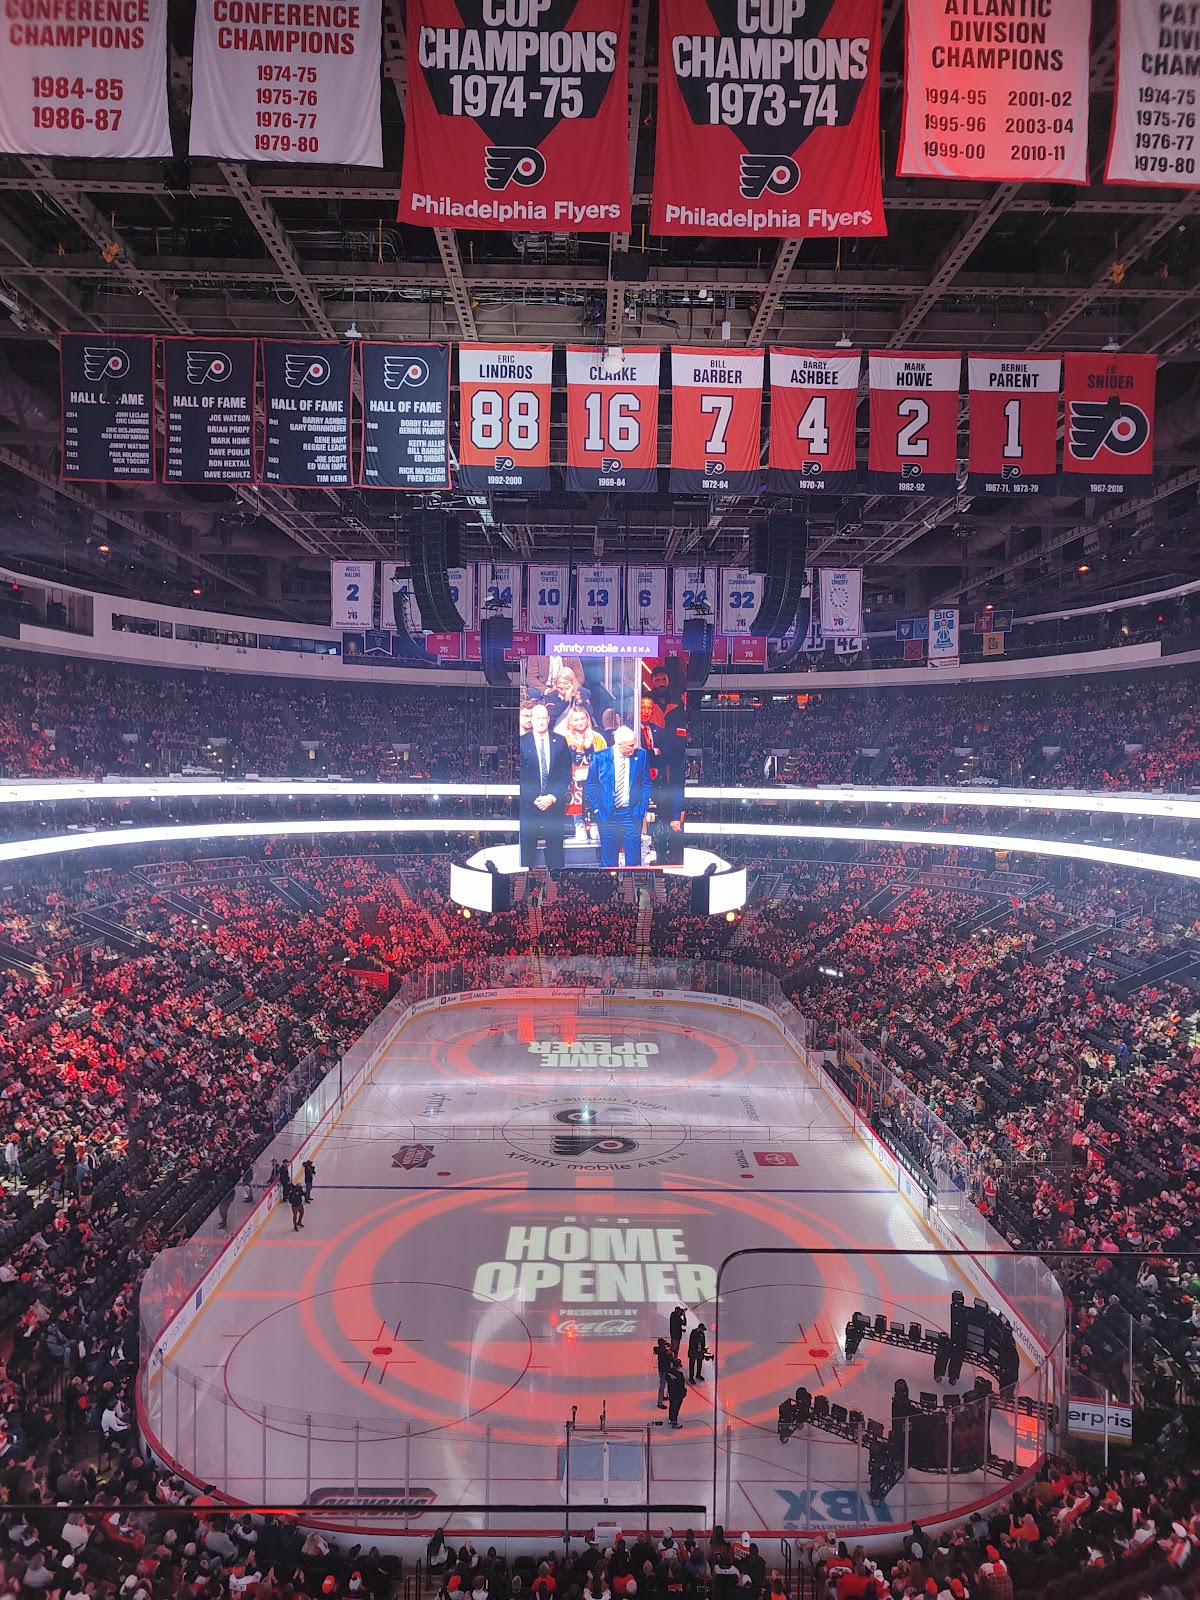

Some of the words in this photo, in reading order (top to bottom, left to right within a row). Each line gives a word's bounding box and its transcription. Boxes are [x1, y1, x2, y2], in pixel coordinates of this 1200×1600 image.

[5, 0, 149, 22] CONFERENCE
[214, 0, 360, 29] CONFERENCE
[482, 0, 552, 28] CUP
[737, 0, 806, 34] CUP
[945, 0, 1052, 18] ATLANTIC
[10, 24, 144, 50] CHAMPIONS
[950, 20, 1046, 43] DIVISION
[218, 26, 355, 55] CHAMPIONS
[418, 26, 617, 74] CHAMPIONS
[672, 35, 870, 80] CHAMPIONS
[932, 46, 1064, 71] CHAMPIONS
[257, 65, 317, 83] 1974-75
[32, 76, 124, 100] 1984-85
[449, 74, 583, 118] 1974-75
[925, 88, 987, 105] 1994-95
[1138, 87, 1196, 105] 1974-75
[256, 88, 318, 106] 1975-76
[707, 82, 838, 126] 1973-74
[1008, 91, 1072, 107] 2001-02
[32, 106, 122, 130] 1986-87
[256, 112, 317, 129] 1976-77
[925, 114, 986, 132] 1995-96
[1006, 118, 1074, 134] 2003-04
[1137, 110, 1196, 128] 1975-76
[254, 134, 319, 152] 1979-80
[1136, 132, 1194, 150] 1976-77
[924, 141, 985, 159] 1999-00
[1011, 145, 1066, 160] 2010-11
[1134, 155, 1196, 174] 1979-80
[411, 193, 546, 221] Philadelphia
[554, 200, 620, 222] Flyers
[666, 203, 800, 231] Philadelphia
[808, 208, 872, 230] Flyers
[479, 364, 532, 380] LINDROS
[710, 360, 726, 368] BILL
[803, 360, 828, 370] BARRY
[904, 363, 926, 372] MARK
[1002, 364, 1028, 372] BERNIE
[590, 367, 637, 380] CLARKE
[694, 370, 742, 384] BARBER
[791, 371, 838, 384] ASHBEE
[897, 372, 932, 386] HOWE
[990, 373, 1039, 388] PARENT
[1088, 374, 1134, 389] SNIDER
[70, 392, 96, 404] HALL
[173, 396, 199, 407] HALL
[202, 396, 214, 408] OF
[218, 397, 246, 408] FAME
[272, 398, 297, 410] HALL
[300, 400, 312, 411] OF
[315, 400, 344, 412] FAME
[370, 400, 396, 412] HALL
[398, 401, 411, 412] OF
[414, 402, 442, 413] FAME
[470, 390, 540, 450] 88
[584, 392, 640, 452] 16
[700, 395, 734, 454] 7
[797, 396, 829, 455] 4
[896, 397, 930, 457] 2
[1003, 399, 1023, 458] 1
[488, 476, 522, 485] 1992-2000
[598, 478, 626, 487] 1969-84
[702, 480, 728, 489] 1972-84
[799, 480, 824, 489] 1970-74
[899, 483, 925, 491] 1982-92
[1013, 484, 1038, 492] 1973-79
[1090, 484, 1124, 492] 1967-2016
[346, 584, 359, 601] 2
[538, 589, 560, 605] 10
[588, 590, 608, 606] 13
[639, 590, 651, 607] 6
[730, 592, 754, 608] 32
[934, 611, 954, 619] BIG
[553, 642, 584, 653] xfinity
[586, 643, 618, 652] mobile
[528, 1042, 660, 1054] OPENER
[540, 1054, 648, 1068] HOME
[638, 1151, 690, 1168] ARENA
[505, 1226, 689, 1262] HOME
[472, 1262, 724, 1302] OPENER
